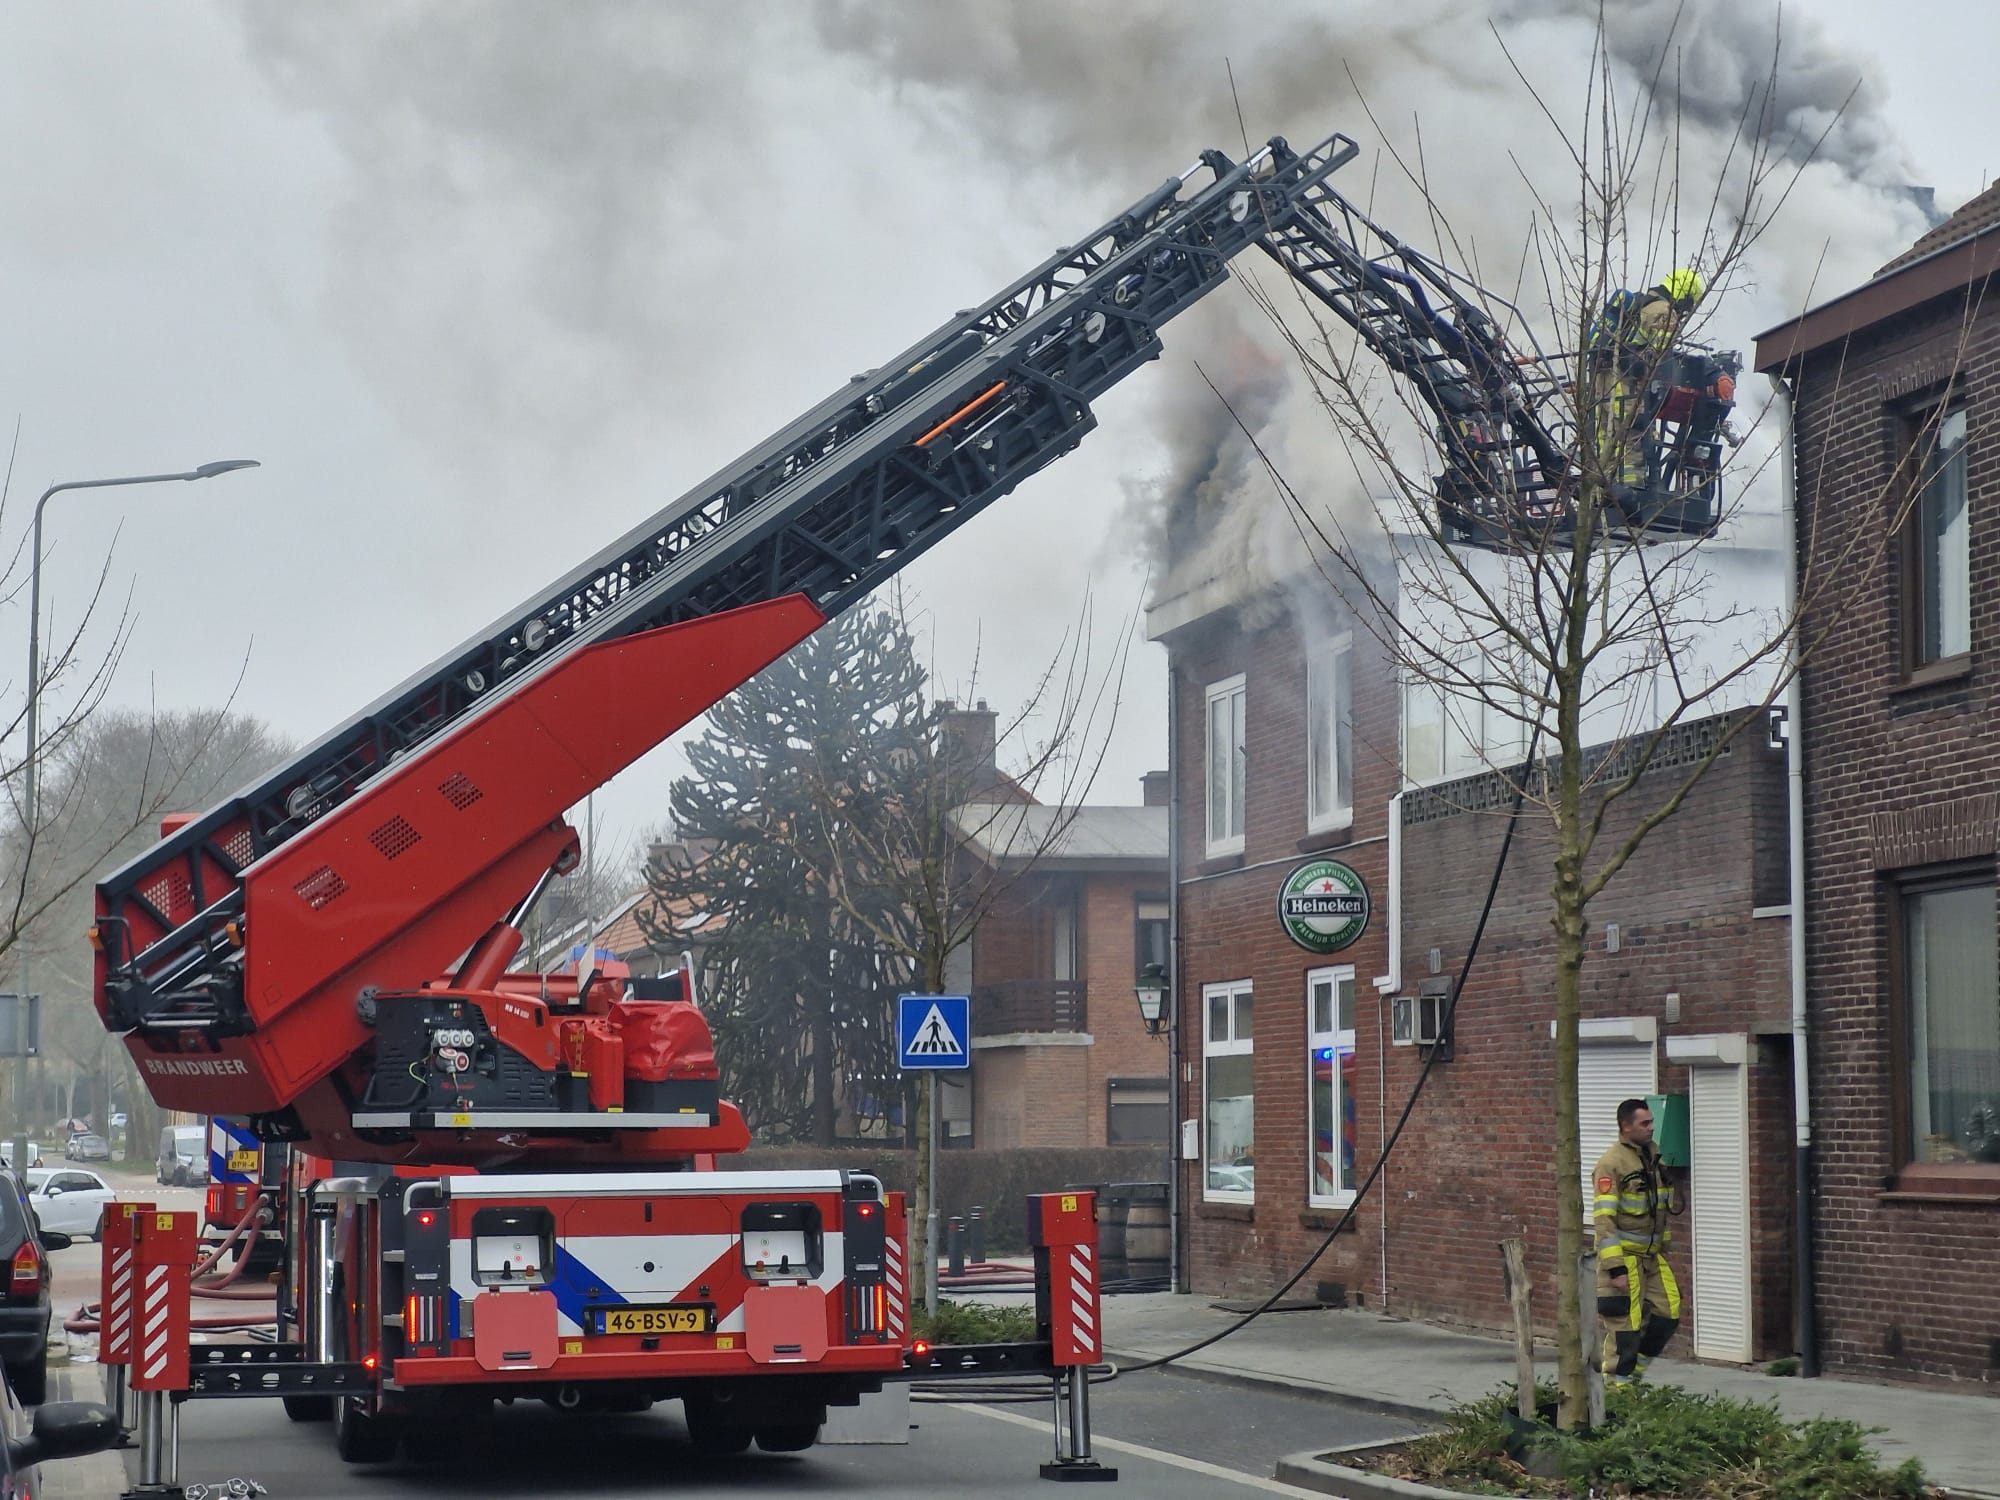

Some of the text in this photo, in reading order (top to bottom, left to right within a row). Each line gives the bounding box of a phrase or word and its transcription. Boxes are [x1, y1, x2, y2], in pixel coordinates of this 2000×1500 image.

[1296, 868, 1355, 889] HEINEKEN PILSENER
[1292, 898, 1361, 913] Heineken
[1296, 922, 1357, 943] PREMIUM QUALITY
[145, 1059, 248, 1075] BRANDWEER
[611, 1312, 697, 1330] 46-BSV-9
